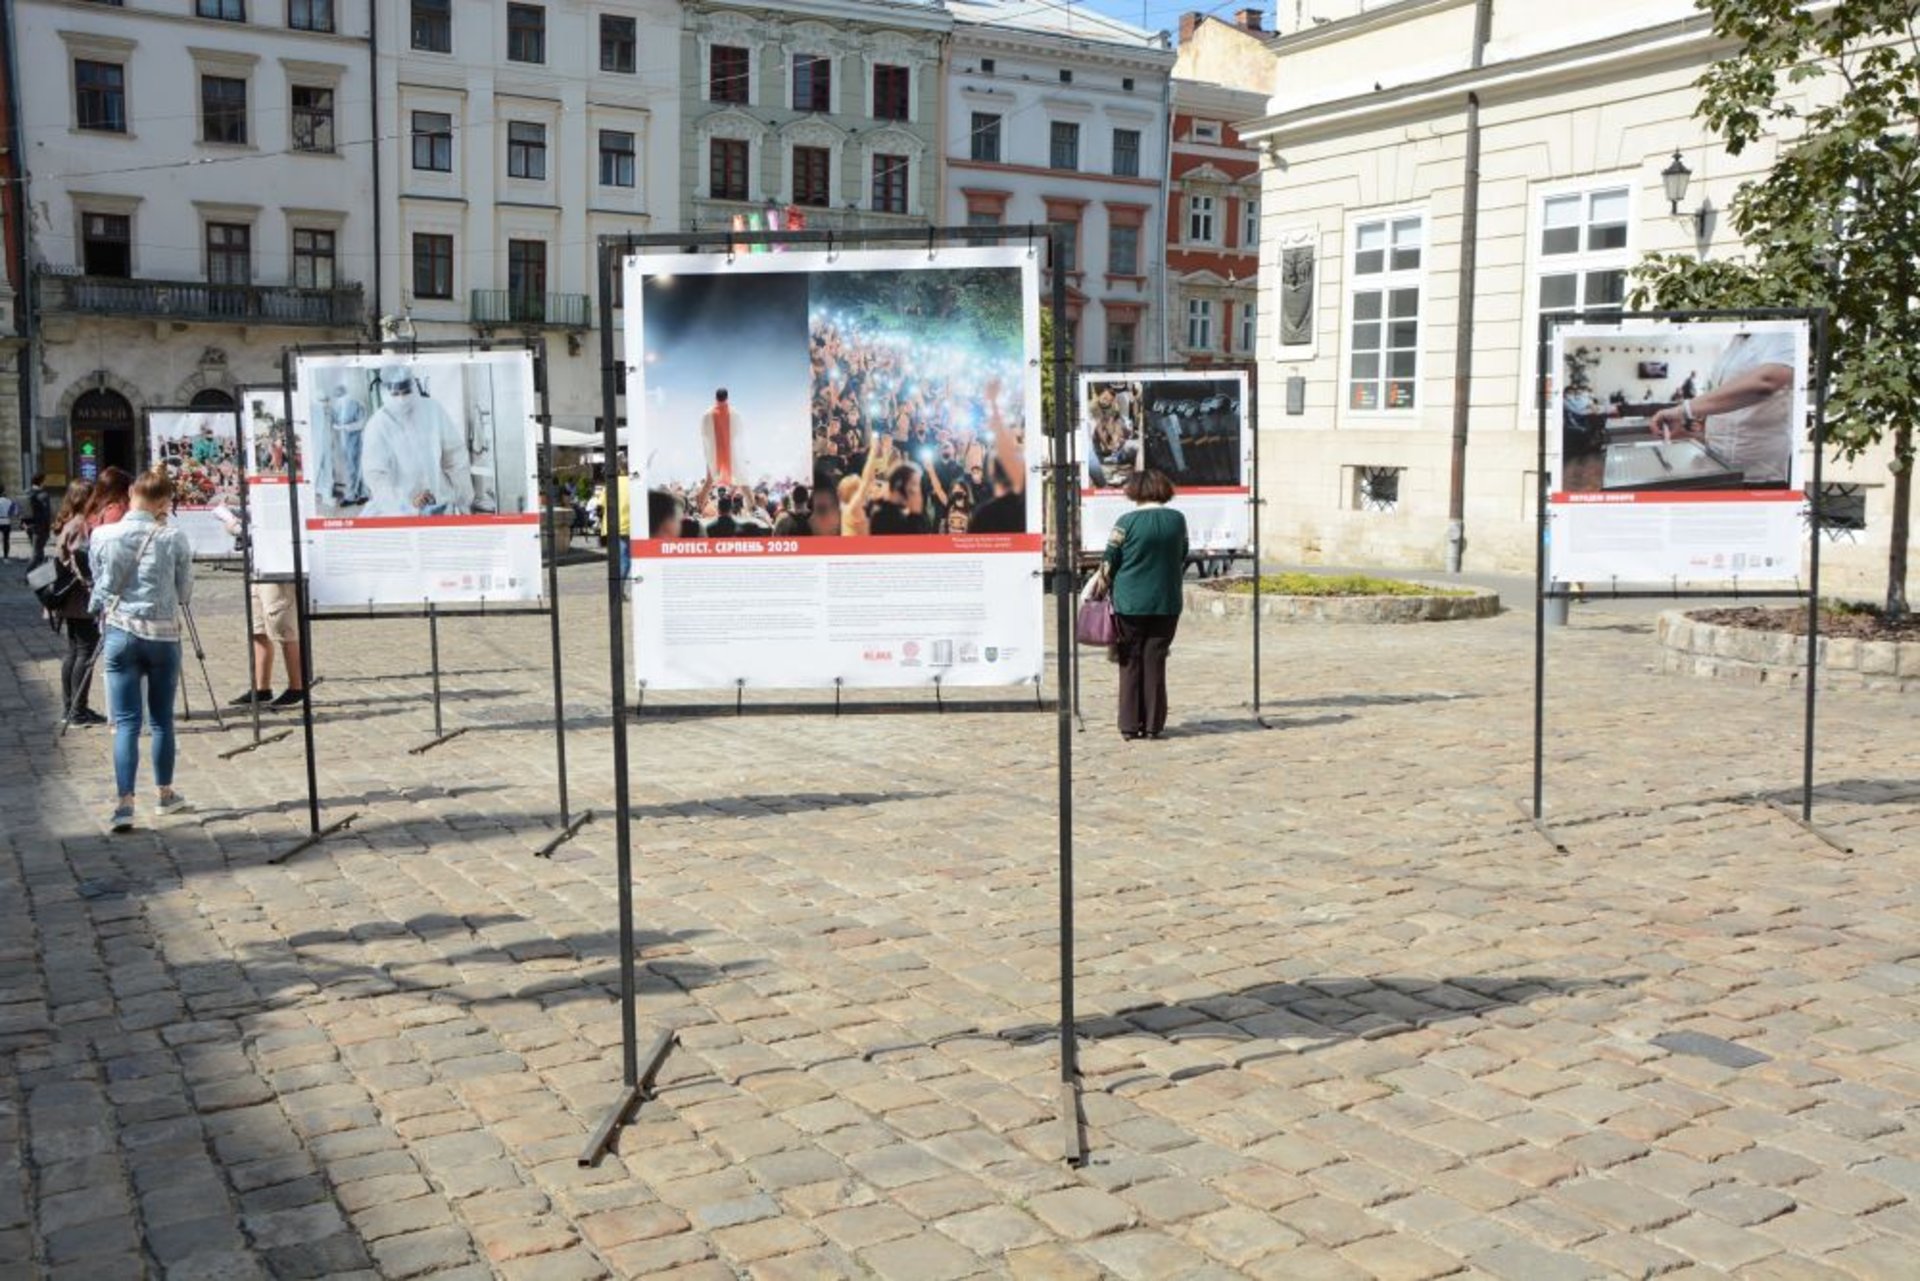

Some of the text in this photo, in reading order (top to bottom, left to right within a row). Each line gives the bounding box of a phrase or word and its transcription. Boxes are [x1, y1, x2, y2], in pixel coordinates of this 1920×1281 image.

[661, 540, 799, 554] ПРОТЕСТ. СЕРПЕНЬ 2020
